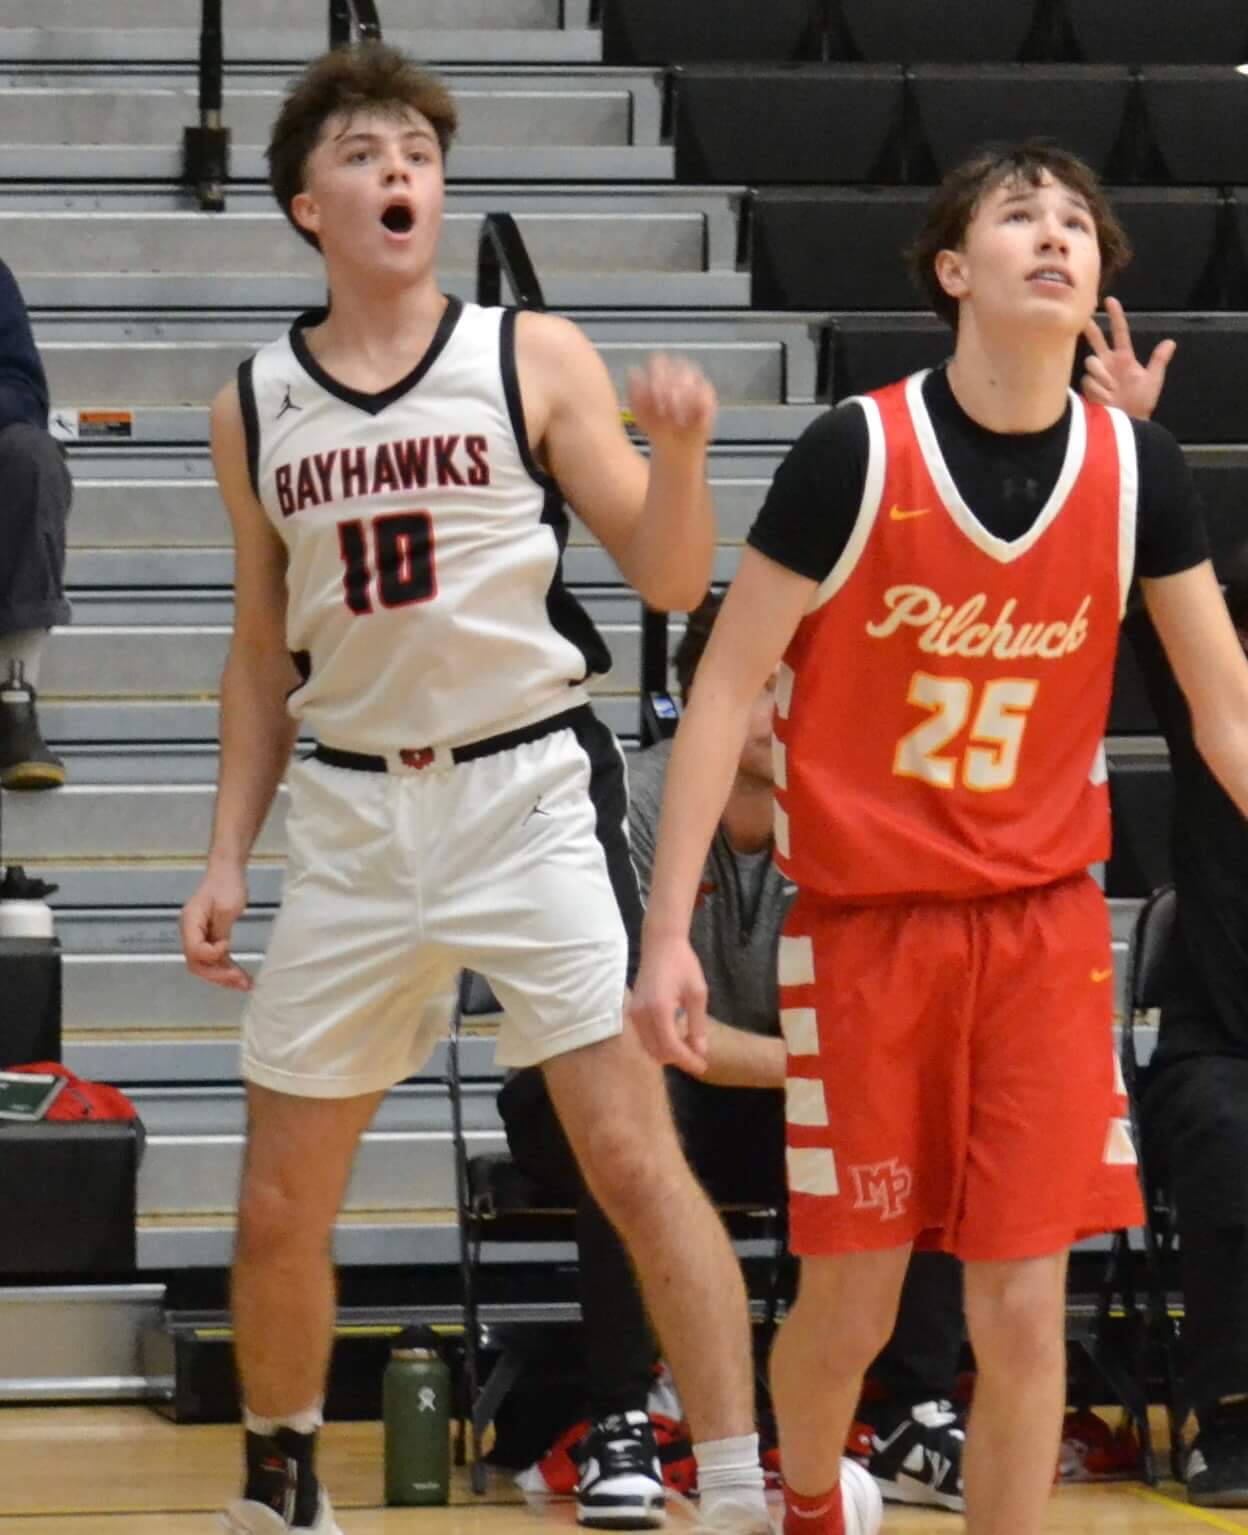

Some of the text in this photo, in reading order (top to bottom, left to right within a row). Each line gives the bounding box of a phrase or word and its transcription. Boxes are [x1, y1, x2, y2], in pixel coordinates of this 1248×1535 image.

[274, 434, 491, 517] BAYHAWKS
[337, 508, 438, 616] 10
[866, 585, 1092, 659] Pilchuck
[892, 670, 1040, 792] 25
